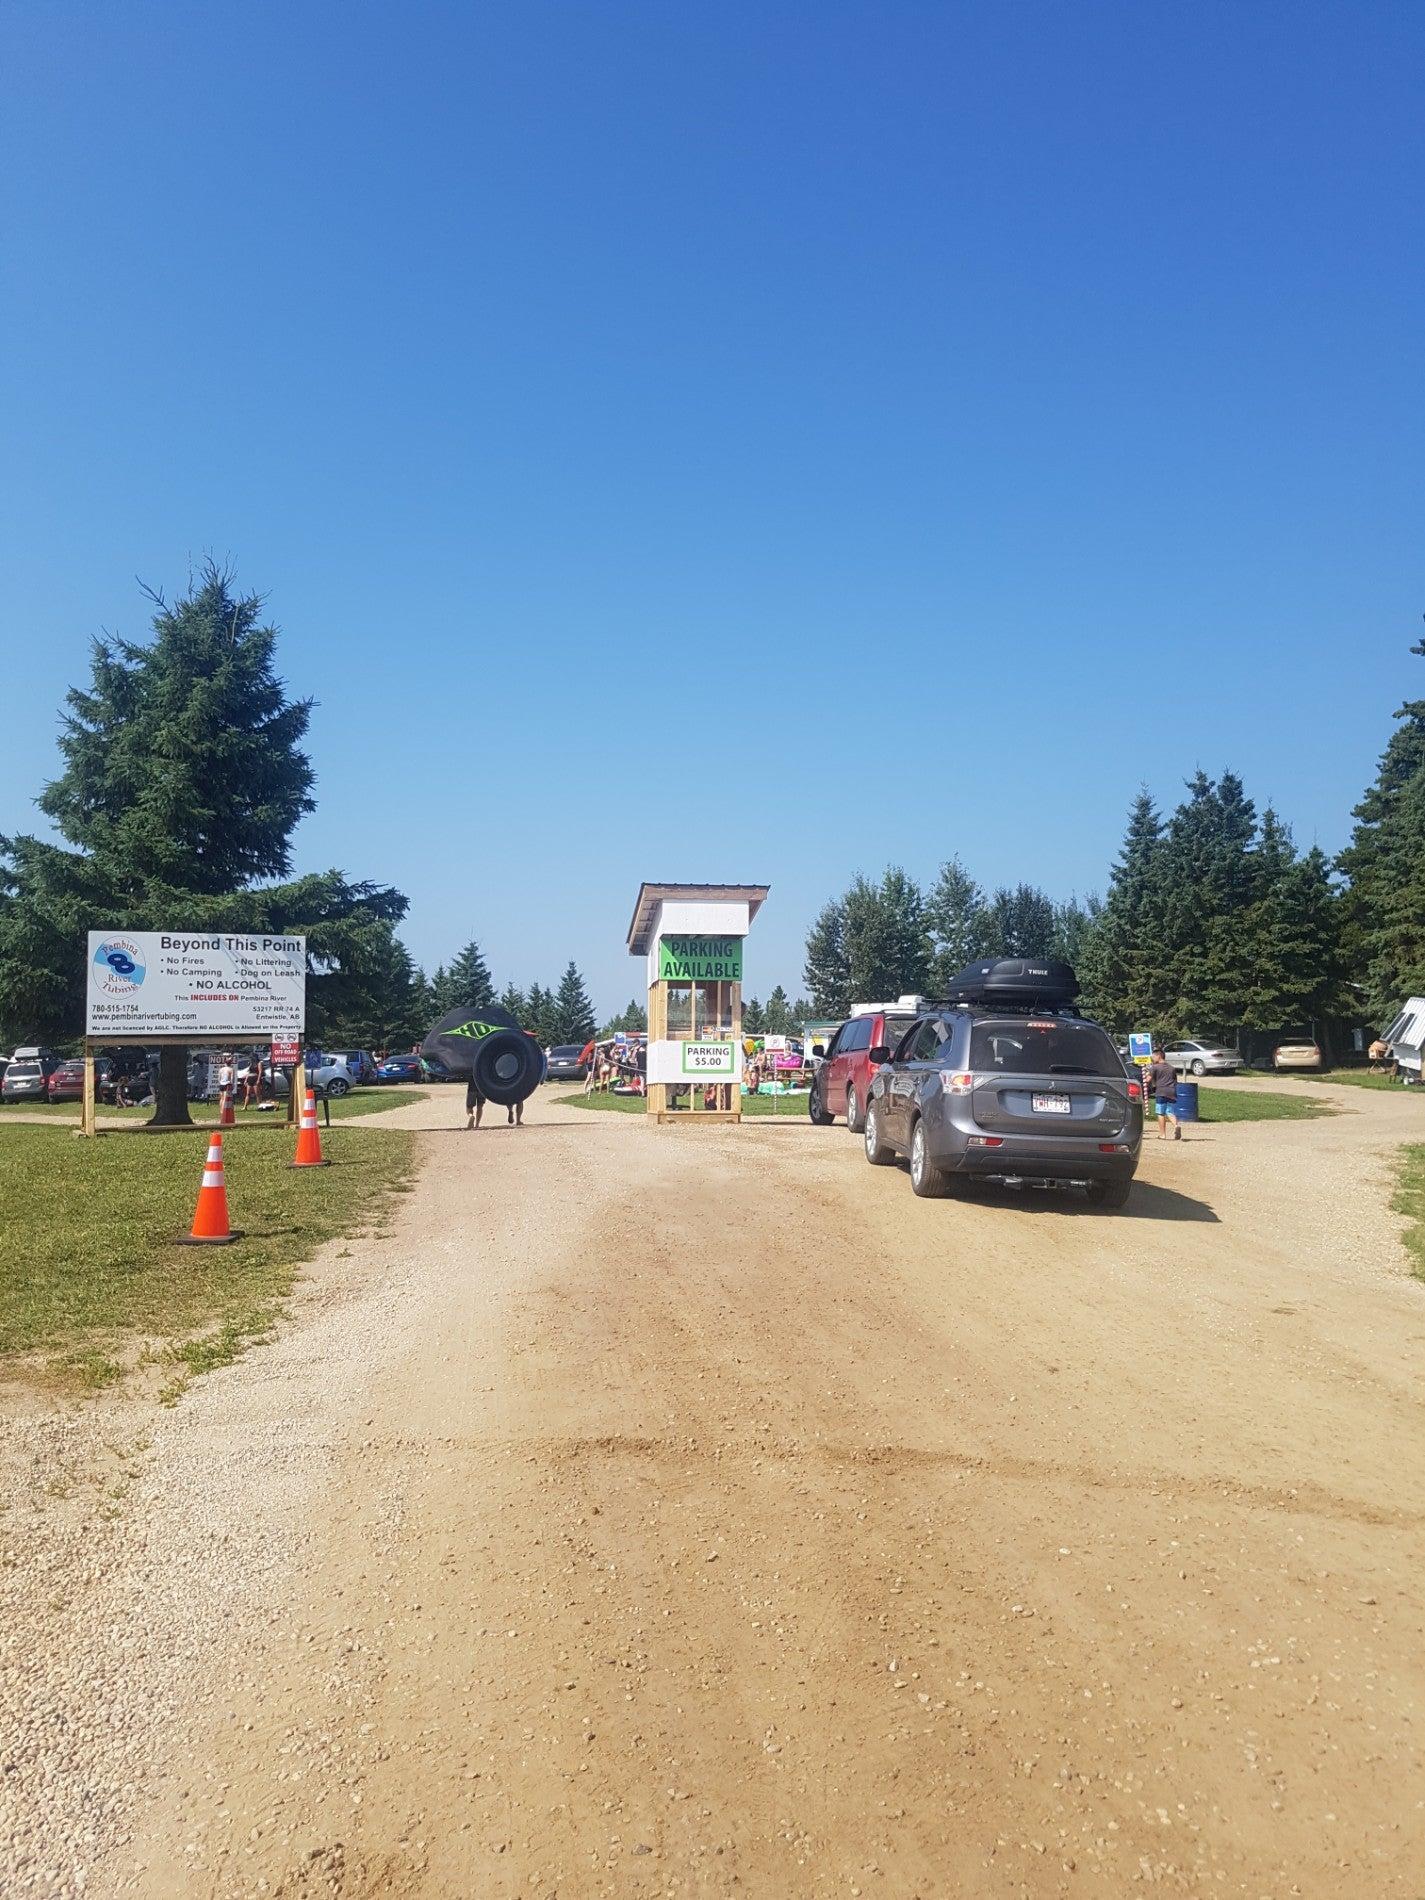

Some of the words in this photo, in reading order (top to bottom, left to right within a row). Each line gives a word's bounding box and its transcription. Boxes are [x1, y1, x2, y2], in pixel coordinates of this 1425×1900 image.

[101, 940, 138, 956] Pembina
[161, 936, 220, 953] Beyond
[225, 938, 258, 951] This
[263, 938, 301, 952] Point
[671, 941, 734, 958] PARKING
[166, 956, 180, 965] No
[182, 956, 205, 965] Fires
[240, 958, 254, 966] No
[255, 958, 292, 968] Littering
[166, 967, 180, 976] No
[182, 967, 223, 978] Camping
[240, 968, 259, 978] Dog
[261, 969, 272, 977] on
[274, 968, 301, 977] Leash
[663, 961, 740, 978] AVAILABLE
[1027, 968, 1048, 976] THULE
[108, 974, 131, 983] River
[102, 981, 138, 994] Tubing
[196, 980, 214, 990] NO
[216, 980, 272, 990] ALCOHOL
[190, 994, 227, 1002] INCLUDES
[92, 1004, 139, 1013] 780-515-1754
[92, 1012, 197, 1022] www.pembinarivertubing.com
[687, 1047, 730, 1056] PARKING
[694, 1057, 722, 1067] $5.00
